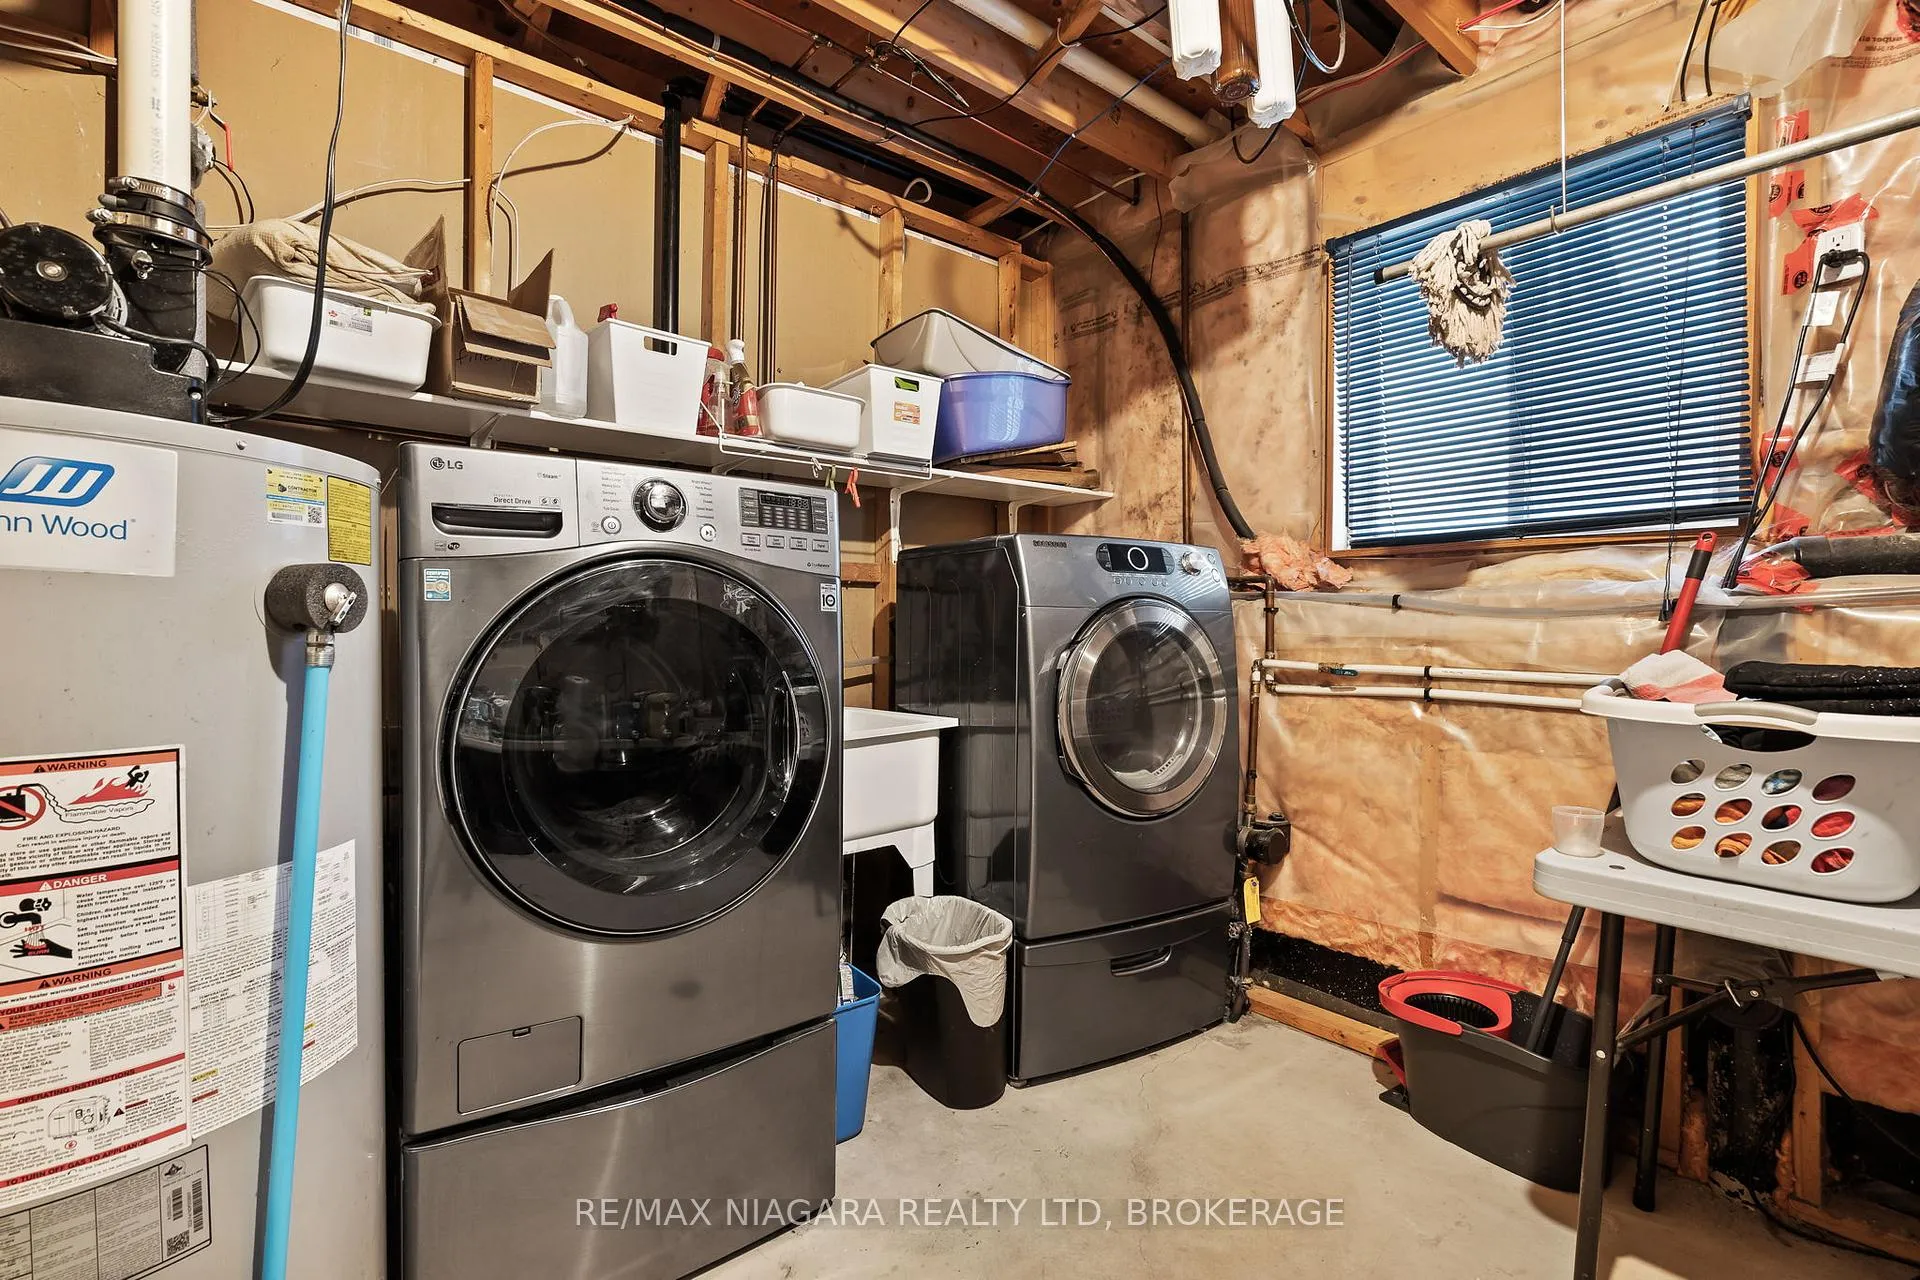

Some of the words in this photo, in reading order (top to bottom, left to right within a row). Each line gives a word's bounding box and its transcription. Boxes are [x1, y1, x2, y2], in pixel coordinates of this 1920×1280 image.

[447, 460, 464, 470] LG
[493, 496, 514, 504] Direct
[514, 497, 532, 505] Drive
[41, 514, 127, 540] Wood
[48, 759, 107, 772] WARNING
[65, 809, 106, 818] Flammable
[109, 806, 134, 814] Vapors
[56, 829, 93, 838] EXPLOSION
[53, 873, 107, 889] DANGER
[97, 886, 131, 895] temperature
[104, 905, 129, 913] disabled
[95, 920, 127, 929] instruction
[99, 924, 134, 934] temperature
[50, 987, 77, 995] warnings
[91, 976, 124, 987] instructions
[131, 968, 157, 978] furnished
[52, 967, 112, 986] WARNING
[0, 1006, 26, 1016] YOUR
[28, 999, 64, 1011] SAFETY
[65, 994, 90, 1004] READ
[91, 986, 126, 998] BEFORE
[127, 976, 165, 990] LIGHTING
[18, 1086, 70, 1104] OPERATING
[72, 1069, 136, 1092] INSTRUCTIONS
[6, 1177, 18, 1187] TO
[19, 1170, 46, 1183] TURN
[48, 1165, 64, 1175] OFF
[67, 1158, 87, 1170] GAS
[88, 1154, 100, 1163] TO
[102, 1139, 149, 1160] APPLIANCE
